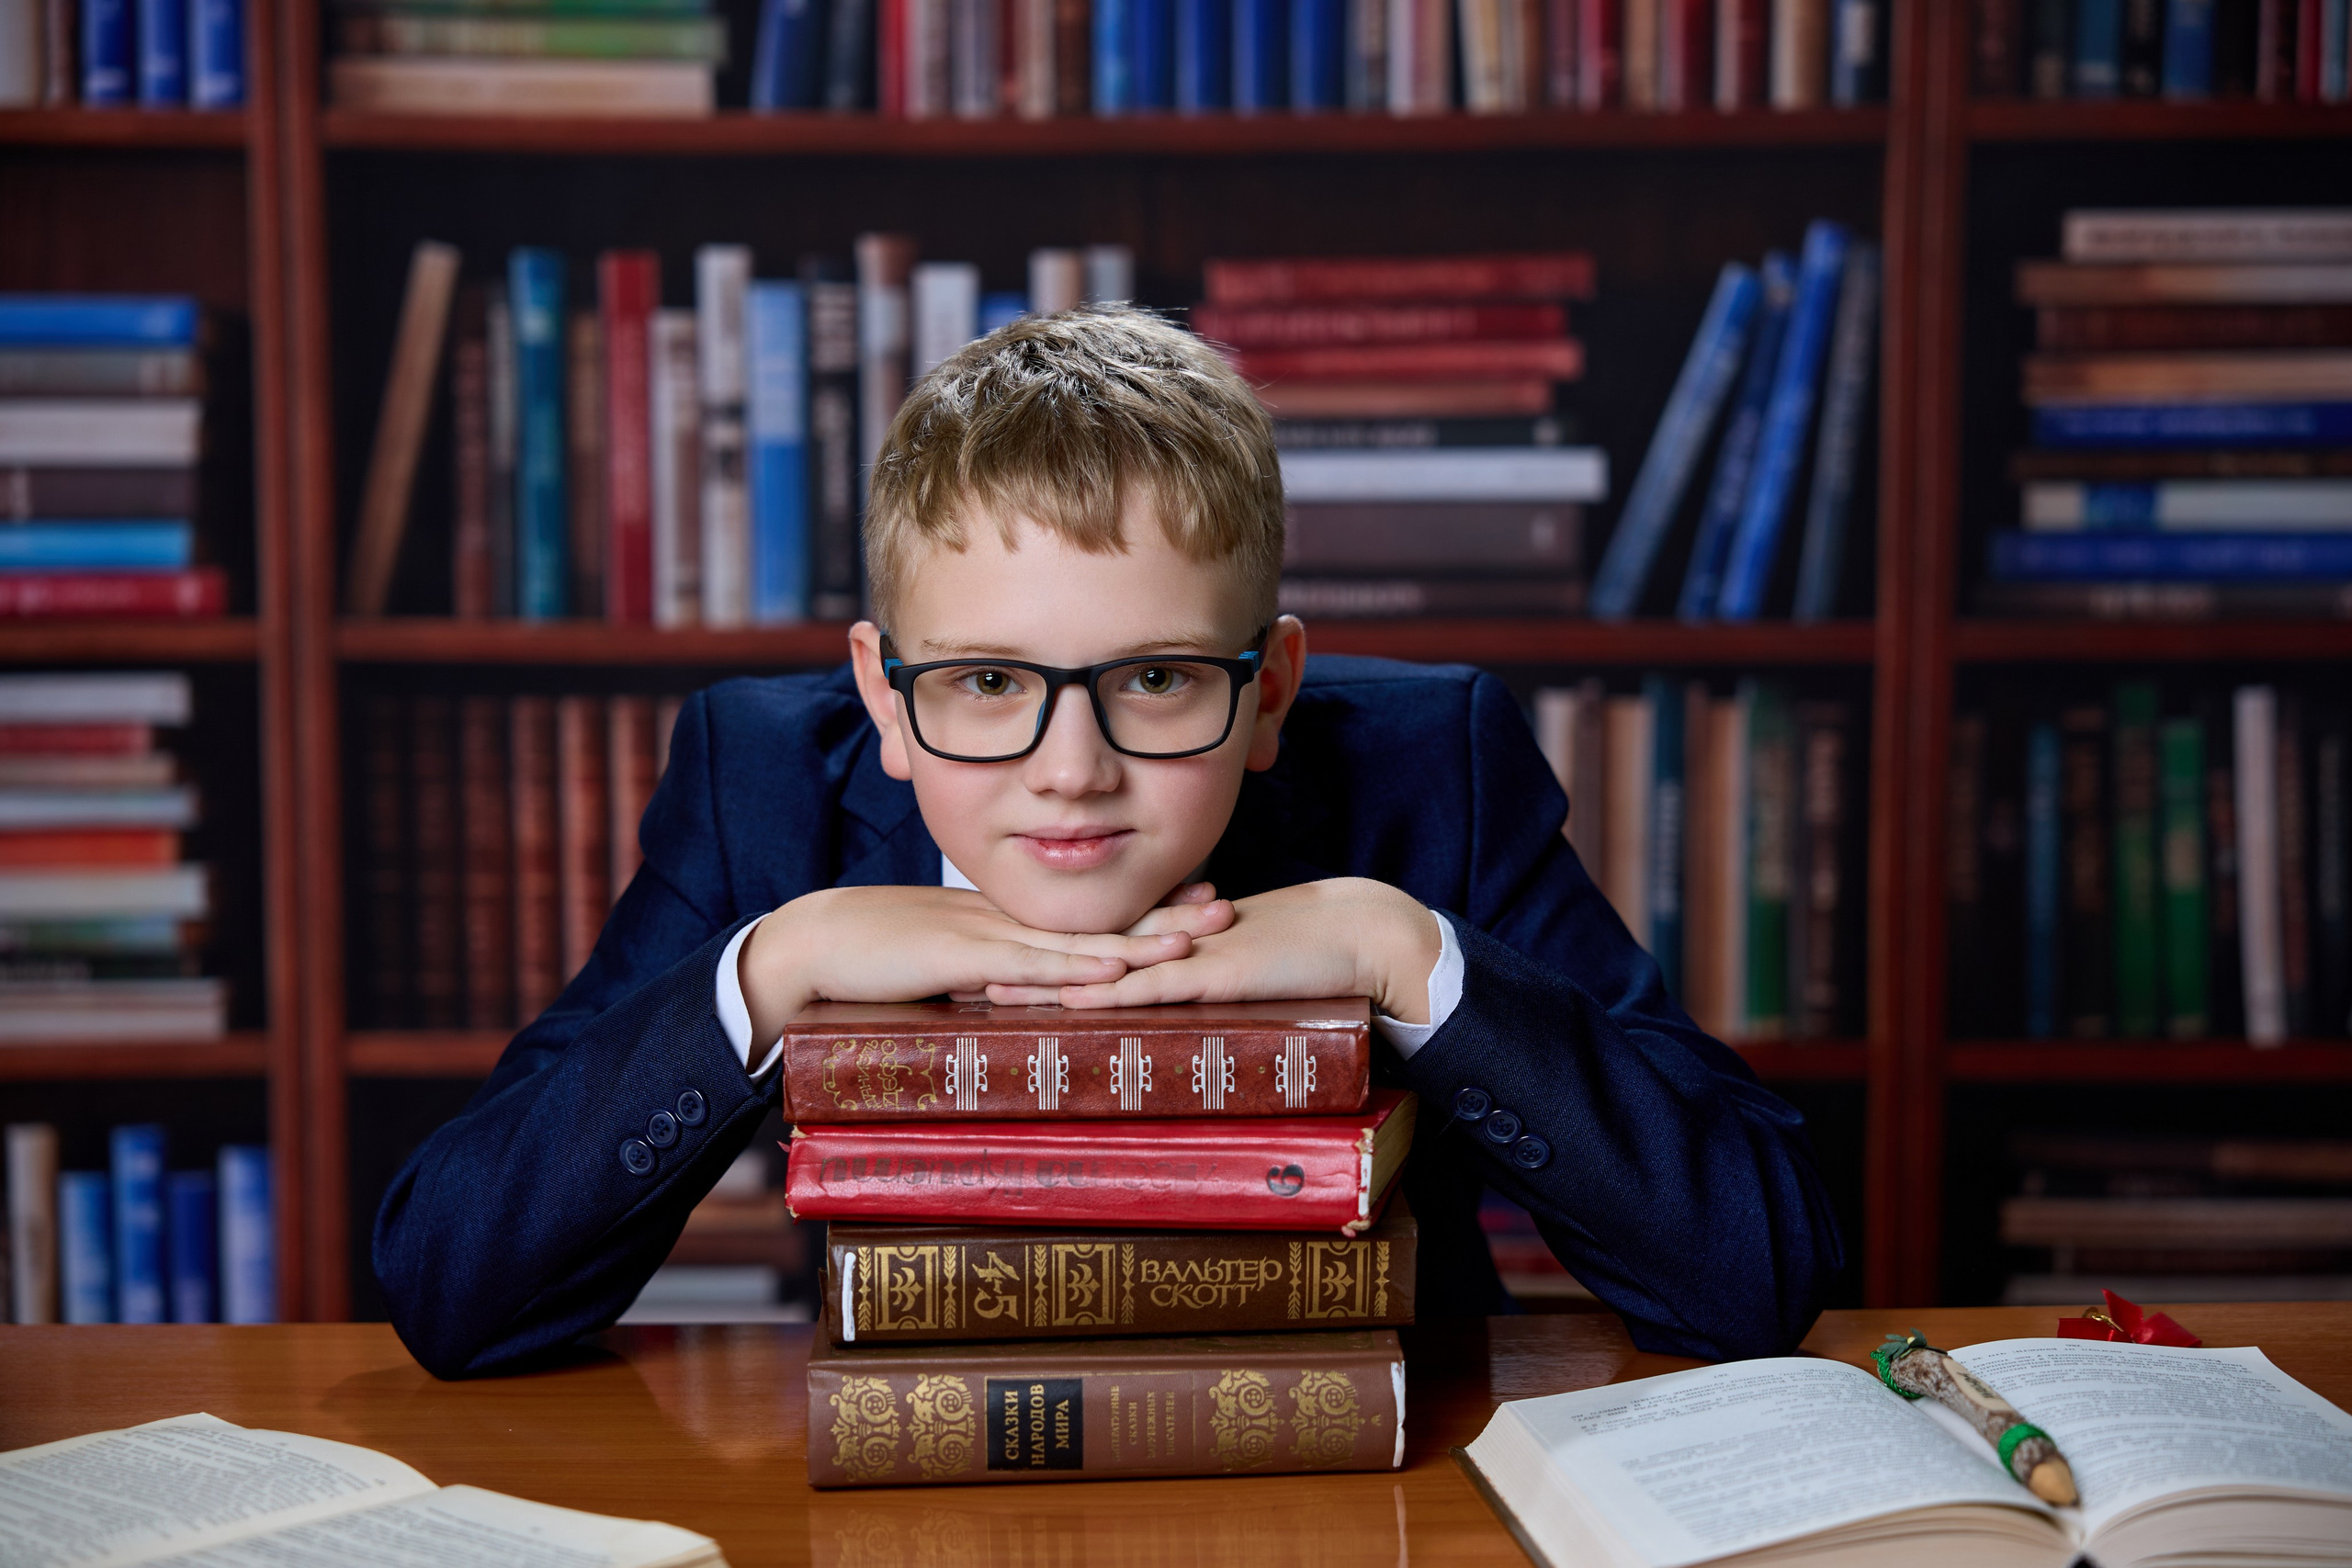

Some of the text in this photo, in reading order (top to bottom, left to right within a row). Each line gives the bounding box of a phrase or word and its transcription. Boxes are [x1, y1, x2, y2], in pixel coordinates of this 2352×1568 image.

[1139, 1256, 1283, 1292] ВАЛЬТЕР
[1149, 1282, 1258, 1310] СКОТТ
[1004, 1390, 1020, 1461] СКАЗКИ
[1029, 1383, 1046, 1466] НАРОДОВ
[1055, 1399, 1070, 1450] МИРА
[1127, 1401, 1138, 1446] СКАЗКИ
